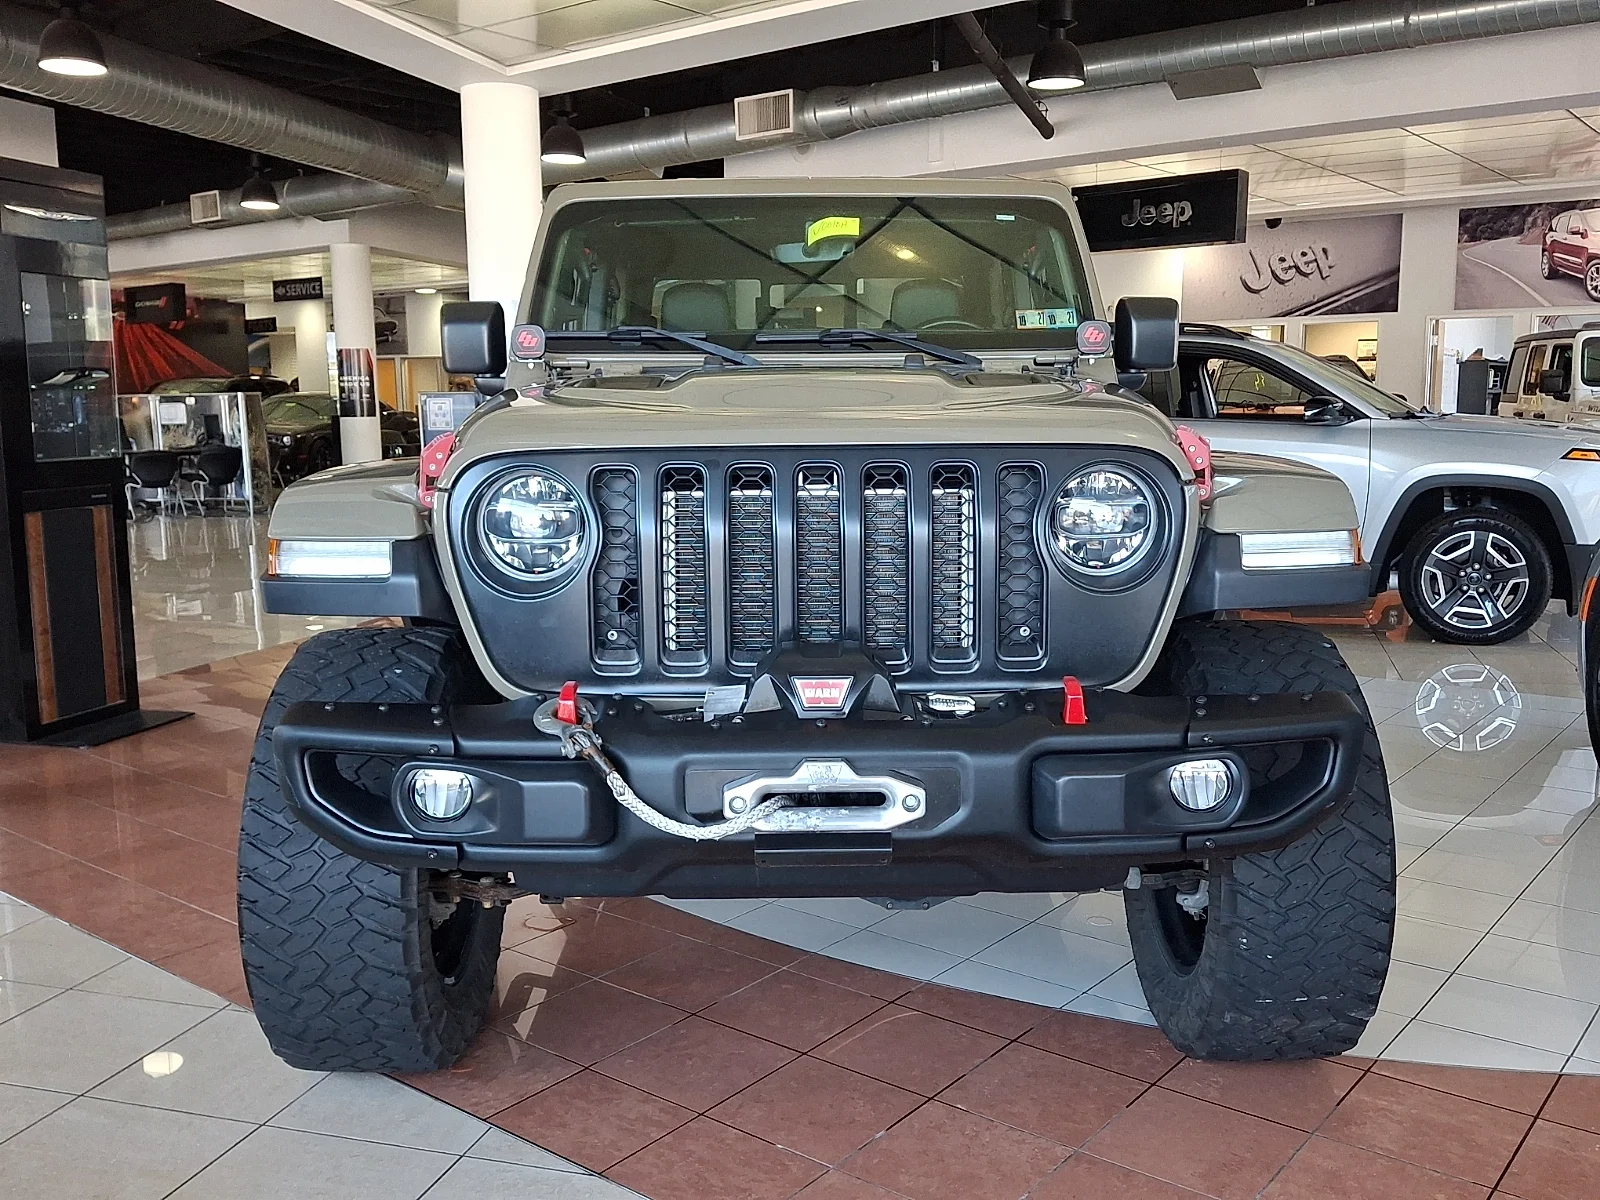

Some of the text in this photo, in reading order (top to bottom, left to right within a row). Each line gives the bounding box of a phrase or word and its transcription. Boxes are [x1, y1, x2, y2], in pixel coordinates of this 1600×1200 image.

[1121, 199, 1192, 228] Jeep
[1239, 243, 1335, 295] Jeep
[286, 282, 321, 296] SERVICE
[803, 687, 840, 698] WARN
